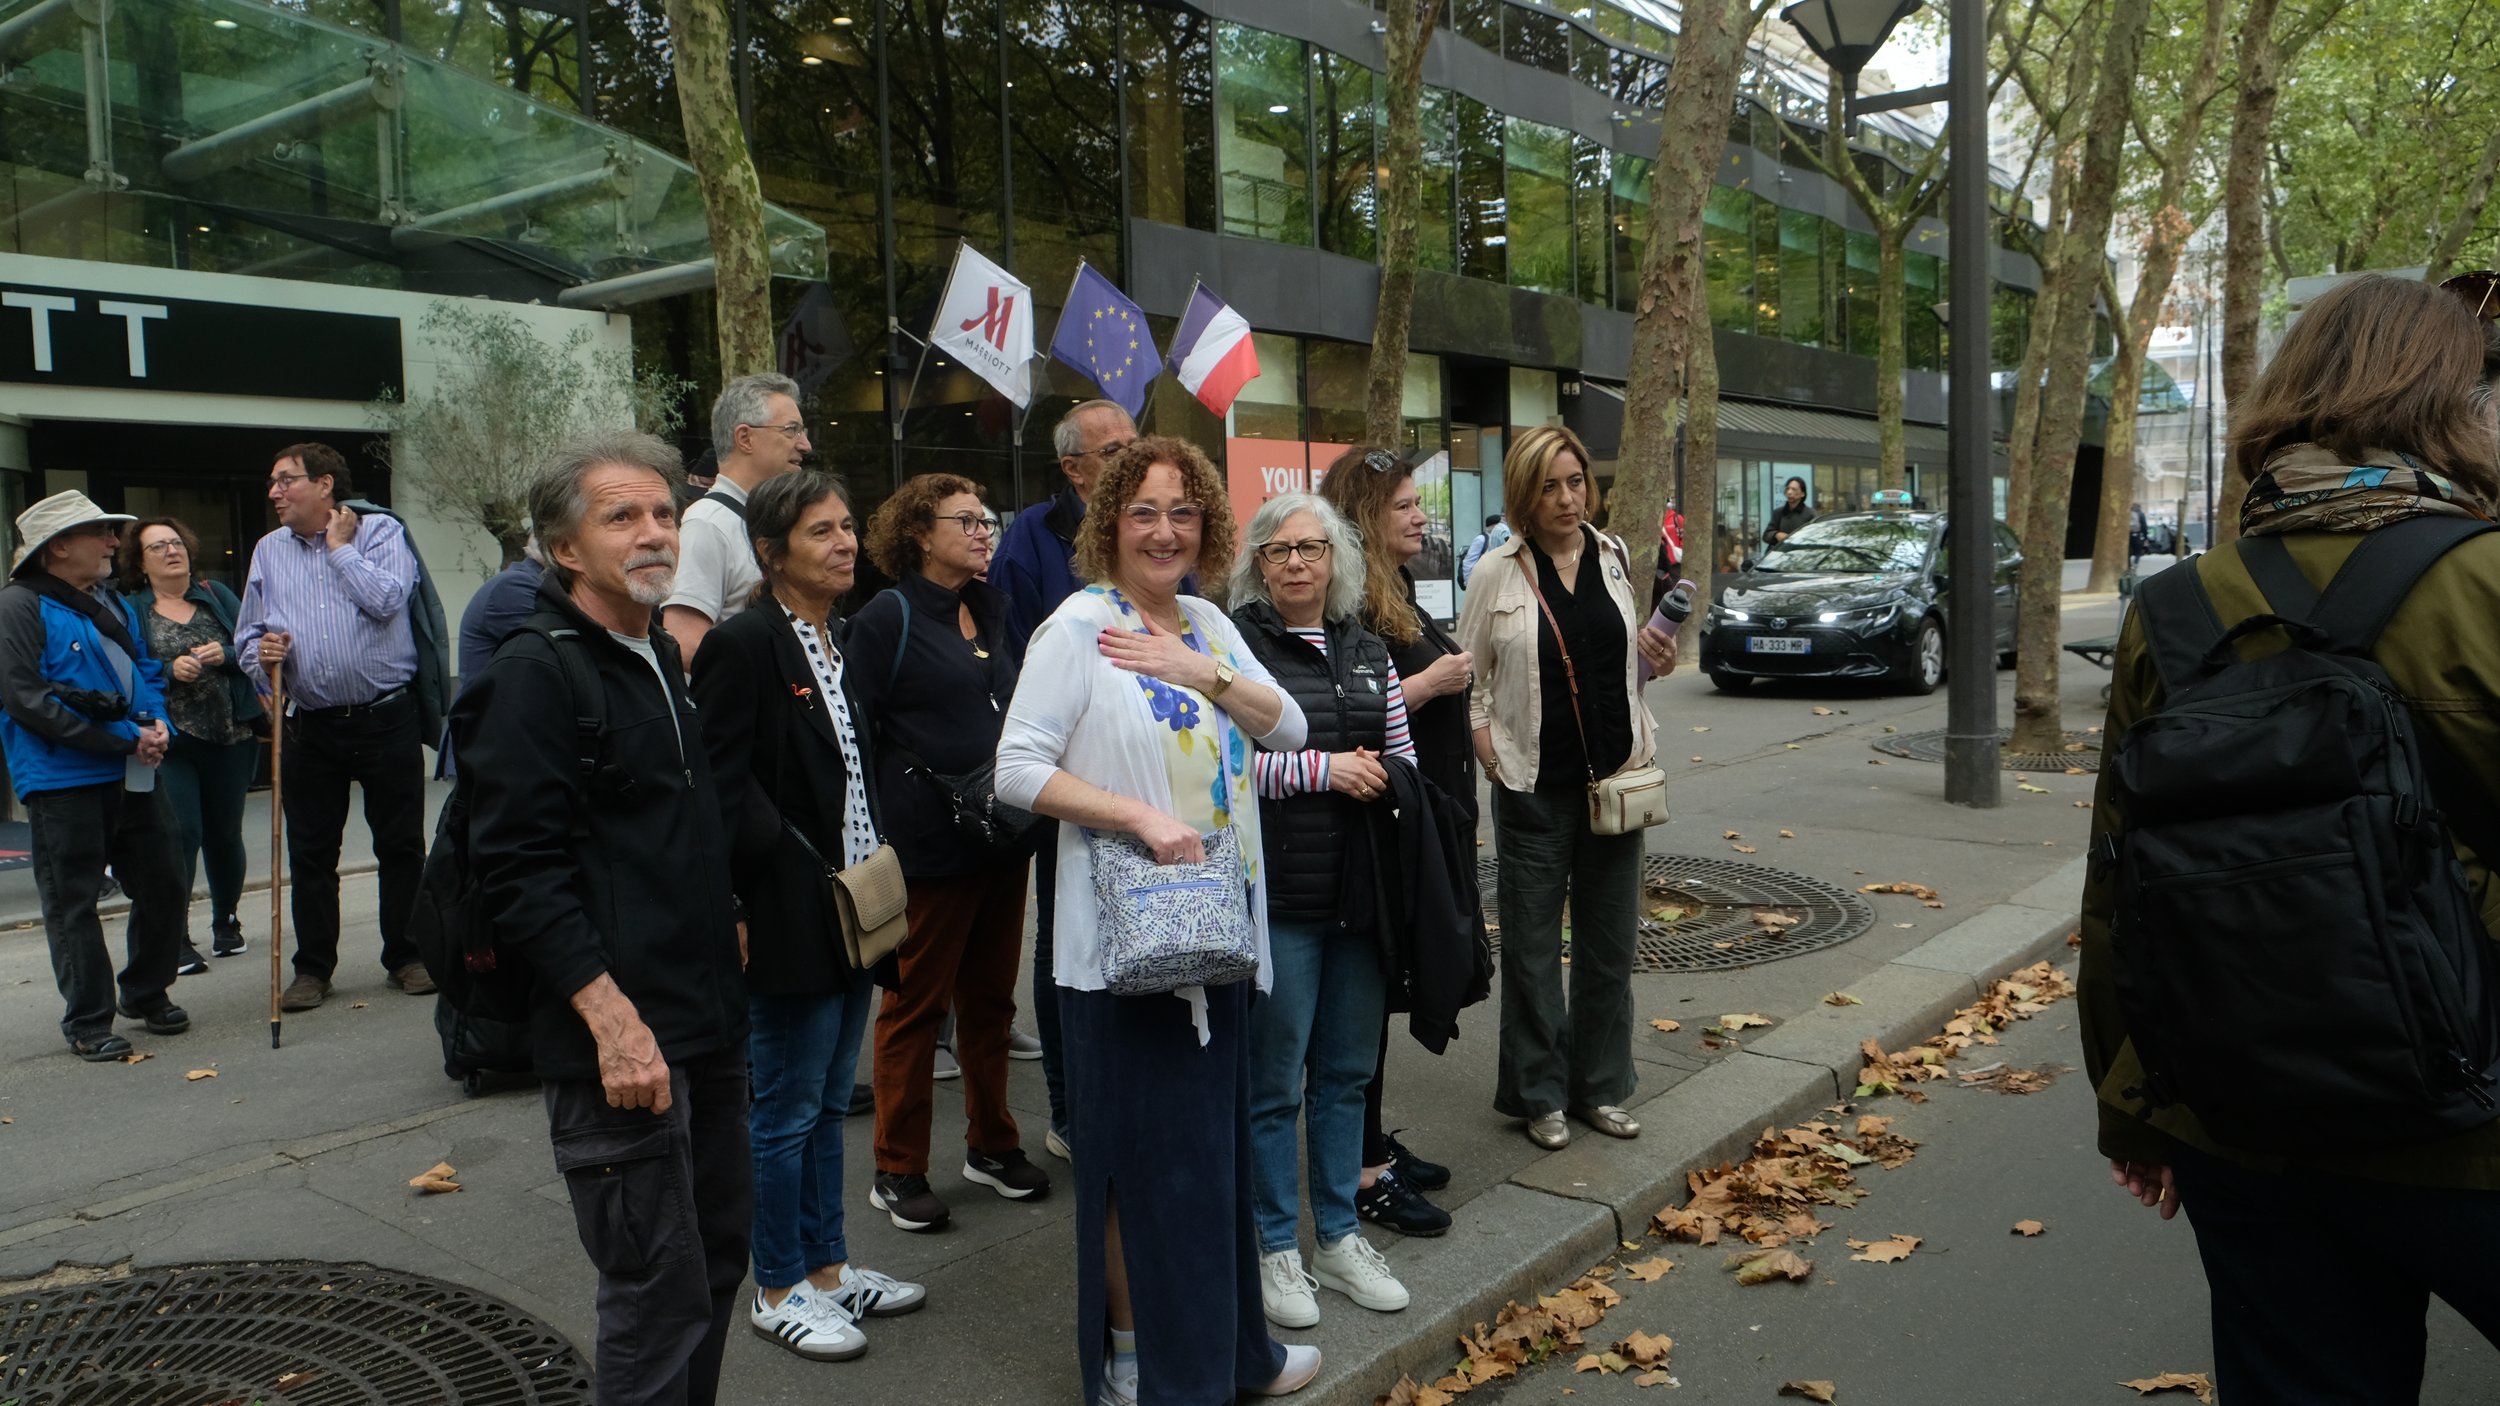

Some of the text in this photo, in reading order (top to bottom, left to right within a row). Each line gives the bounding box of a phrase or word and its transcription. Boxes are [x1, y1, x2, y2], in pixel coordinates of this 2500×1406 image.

[1, 291, 169, 378] TT
[965, 337, 1012, 376] MARRIOTT
[1261, 466, 1303, 495] YOU
[1752, 639, 1804, 652] HA-333-MR
